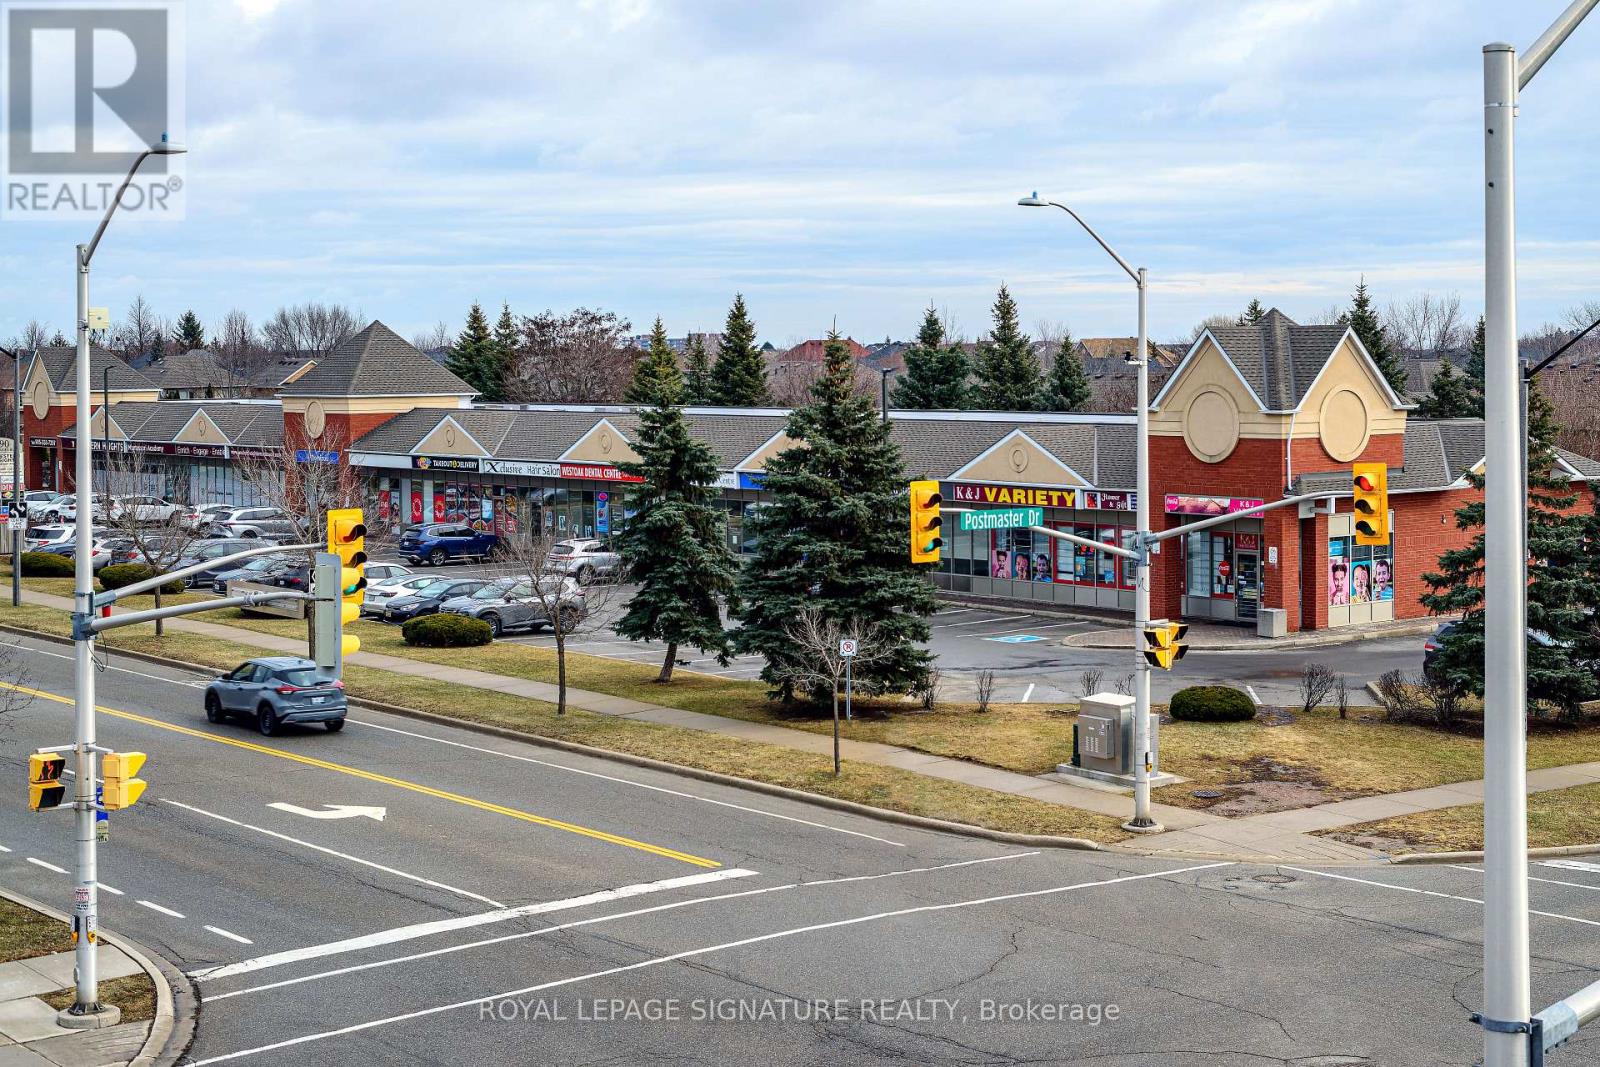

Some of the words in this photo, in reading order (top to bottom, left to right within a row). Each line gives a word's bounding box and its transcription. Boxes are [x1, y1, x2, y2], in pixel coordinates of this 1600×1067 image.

[457, 461, 478, 469] DELIVERY
[485, 462, 522, 474] Xclusive
[527, 465, 541, 475] Hair
[542, 465, 560, 476] Salon
[585, 467, 602, 478] DENTAL
[984, 487, 1076, 506] VARIETY
[965, 511, 1024, 530] Postmaster
[1028, 509, 1040, 527] Dr
